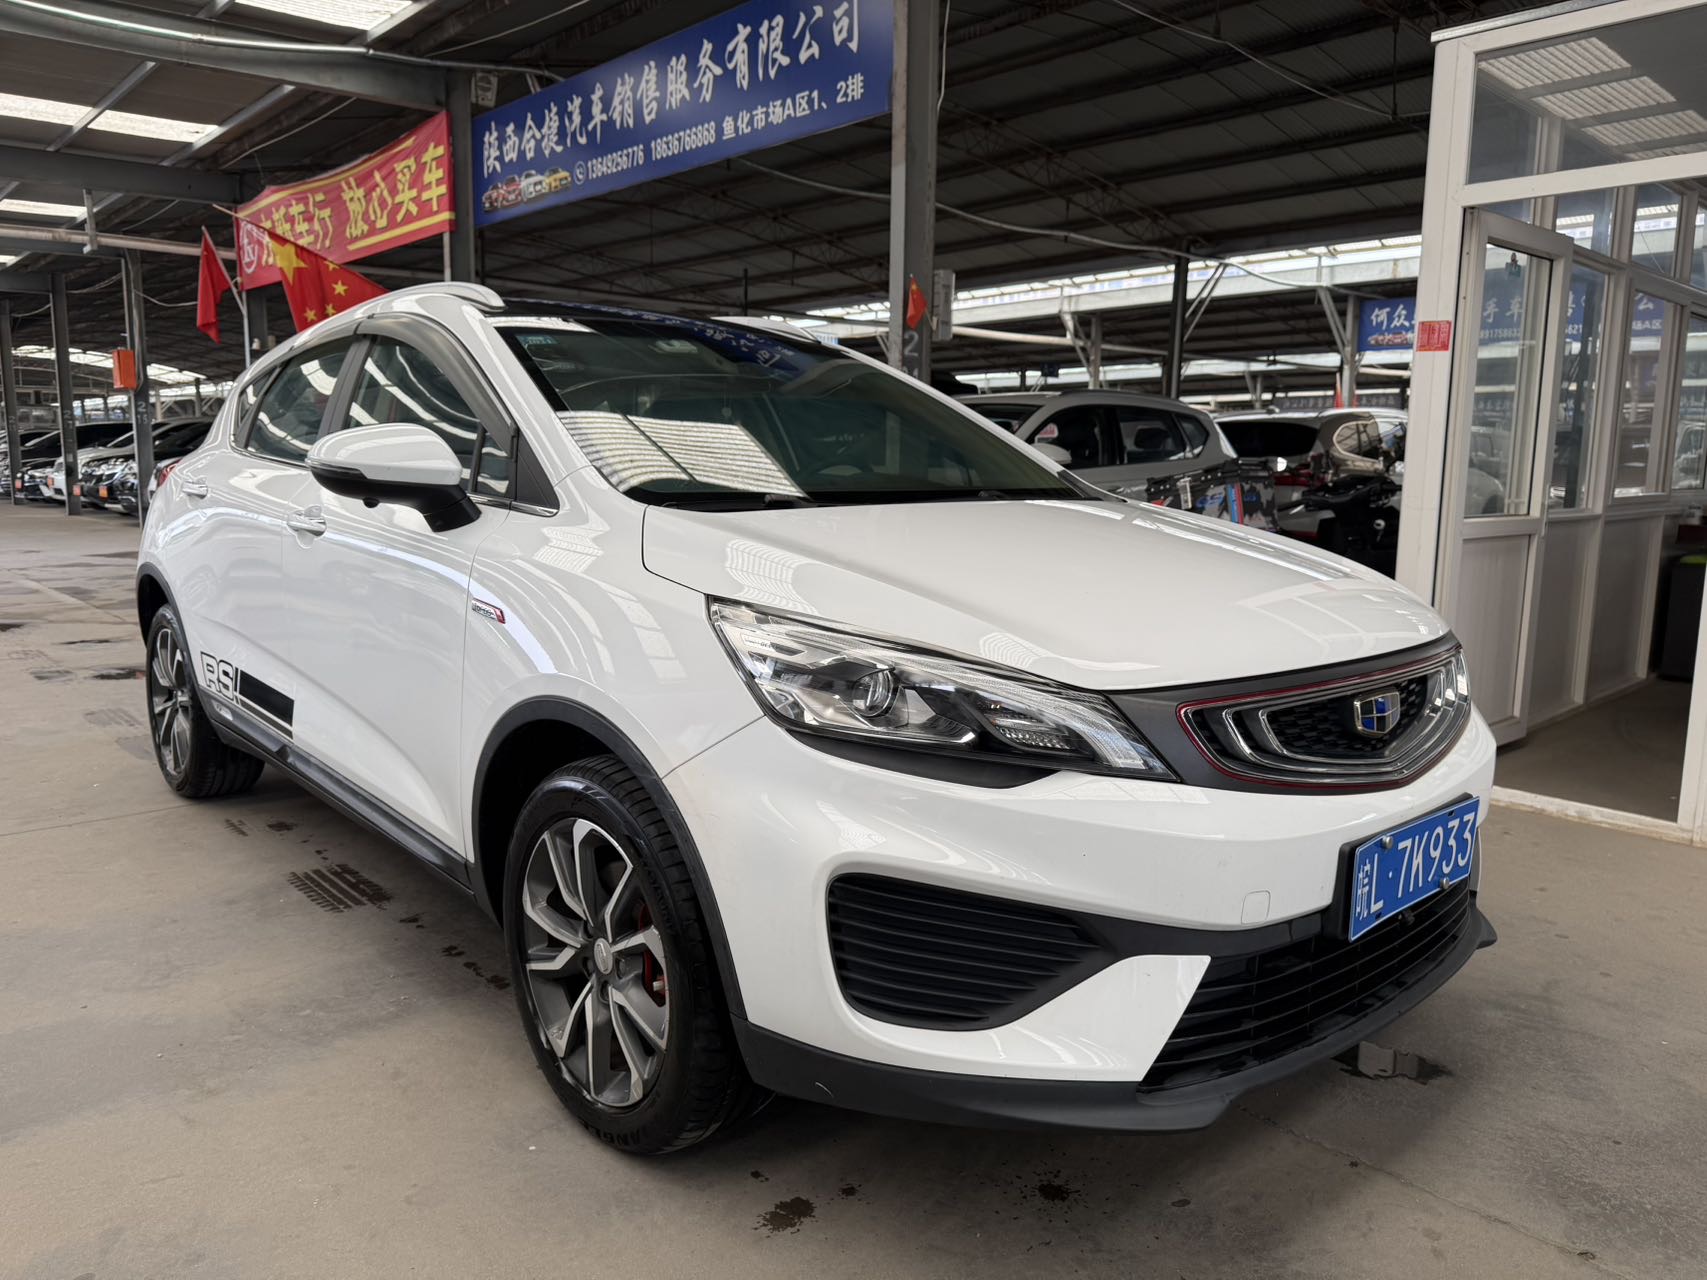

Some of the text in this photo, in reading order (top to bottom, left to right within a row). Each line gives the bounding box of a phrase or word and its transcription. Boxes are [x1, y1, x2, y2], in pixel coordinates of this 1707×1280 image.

[651, 121, 716, 160] 18636766868
[341, 142, 447, 240] 放心买车
[904, 331, 919, 356] 2
